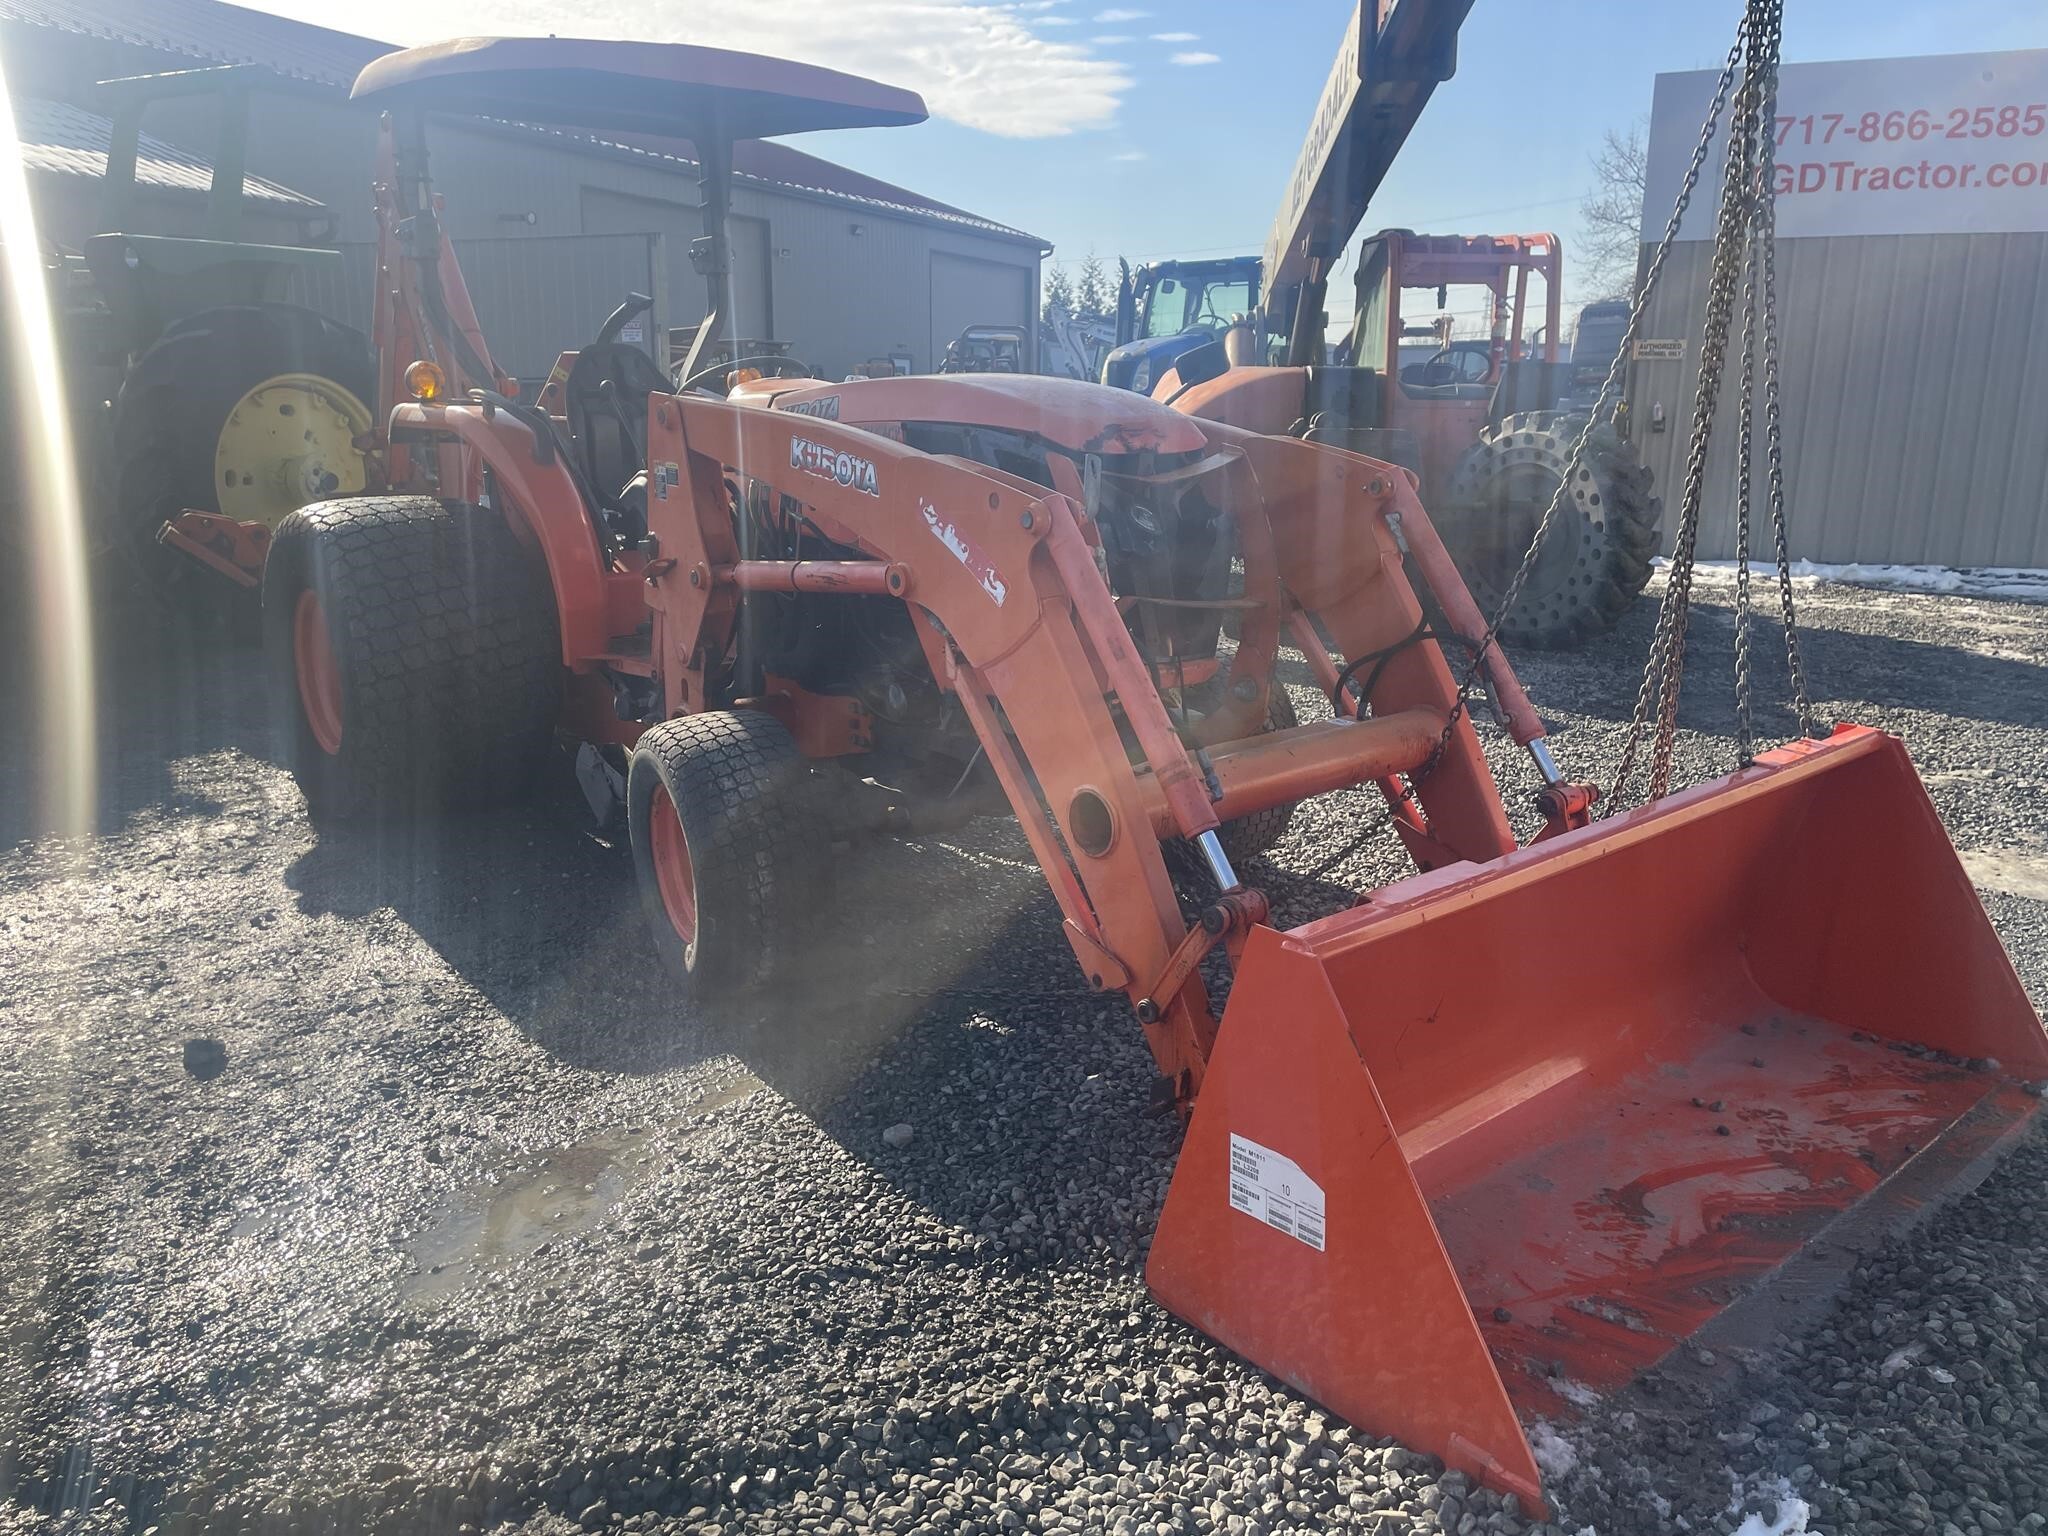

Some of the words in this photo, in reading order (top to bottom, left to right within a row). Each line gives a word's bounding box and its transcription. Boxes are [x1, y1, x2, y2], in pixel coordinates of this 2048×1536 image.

[1774, 104, 2047, 147] 717-866-2585
[1752, 160, 2048, 195] GDTractor.co
[790, 434, 880, 497] KUBOTA
[1281, 1183, 1291, 1197] 10
